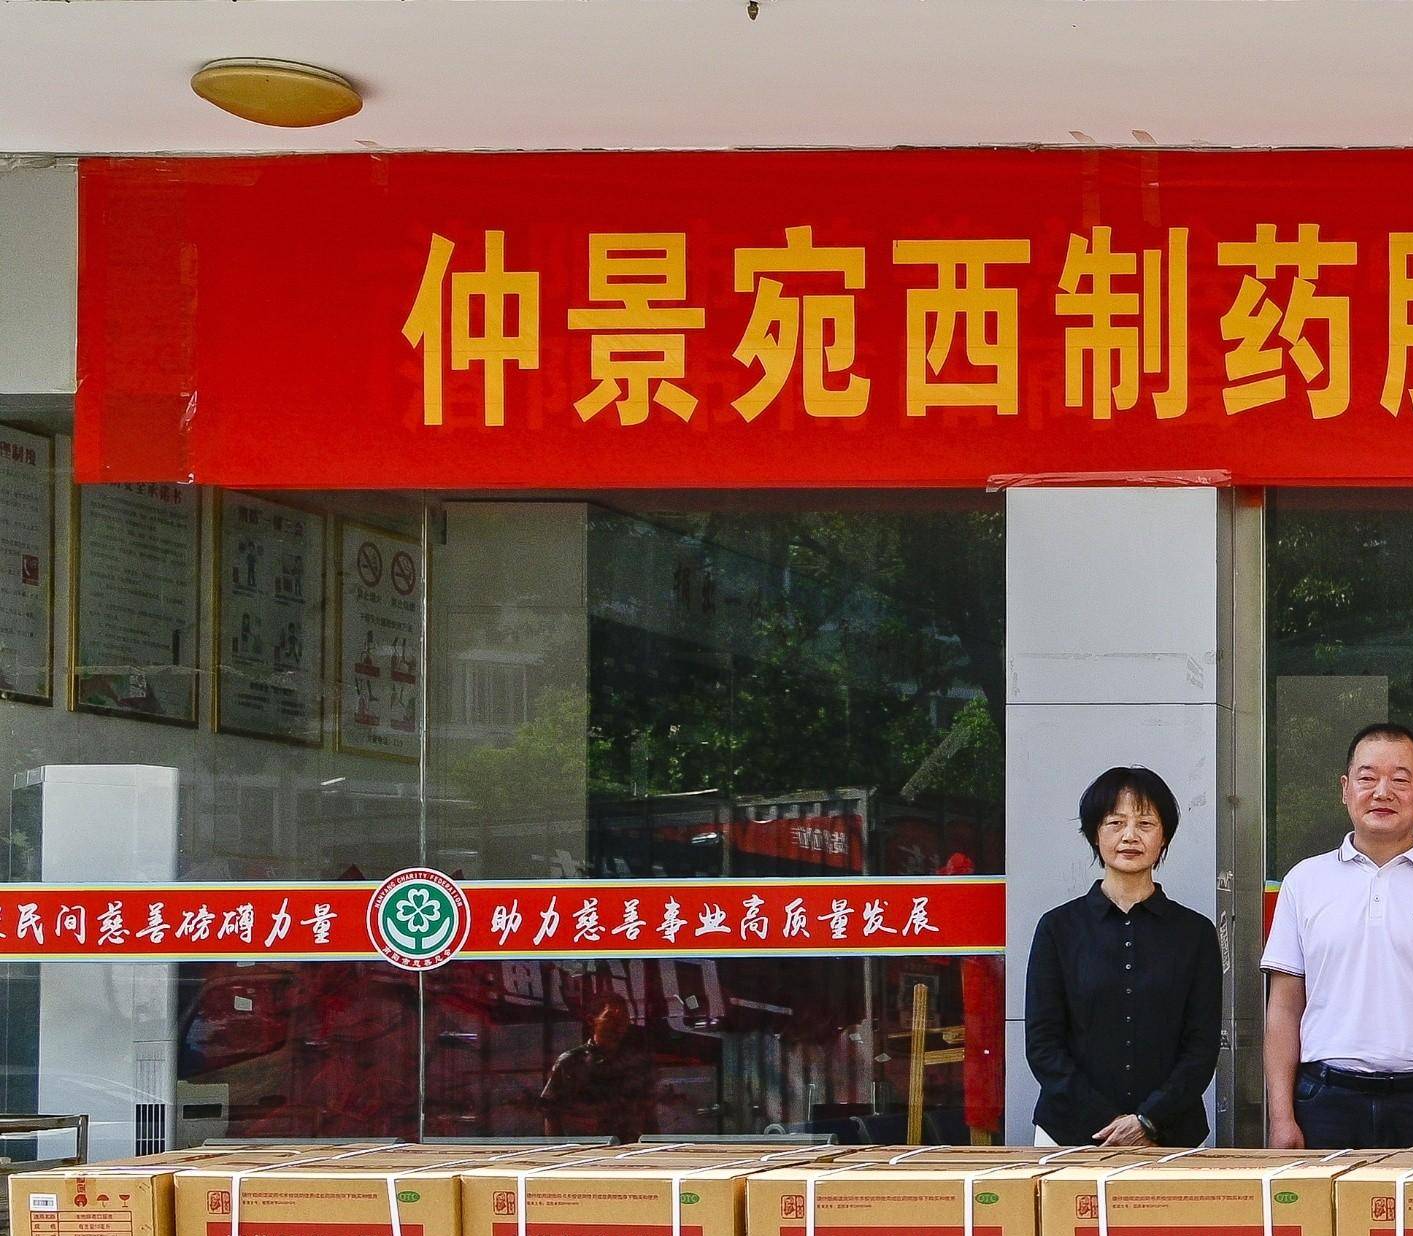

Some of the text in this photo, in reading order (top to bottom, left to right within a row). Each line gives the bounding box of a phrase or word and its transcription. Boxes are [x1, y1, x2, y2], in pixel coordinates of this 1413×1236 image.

[0, 898, 337, 947] 民间慈善磅礴力量
[490, 894, 940, 945] 助力慈善事业高质量发展
